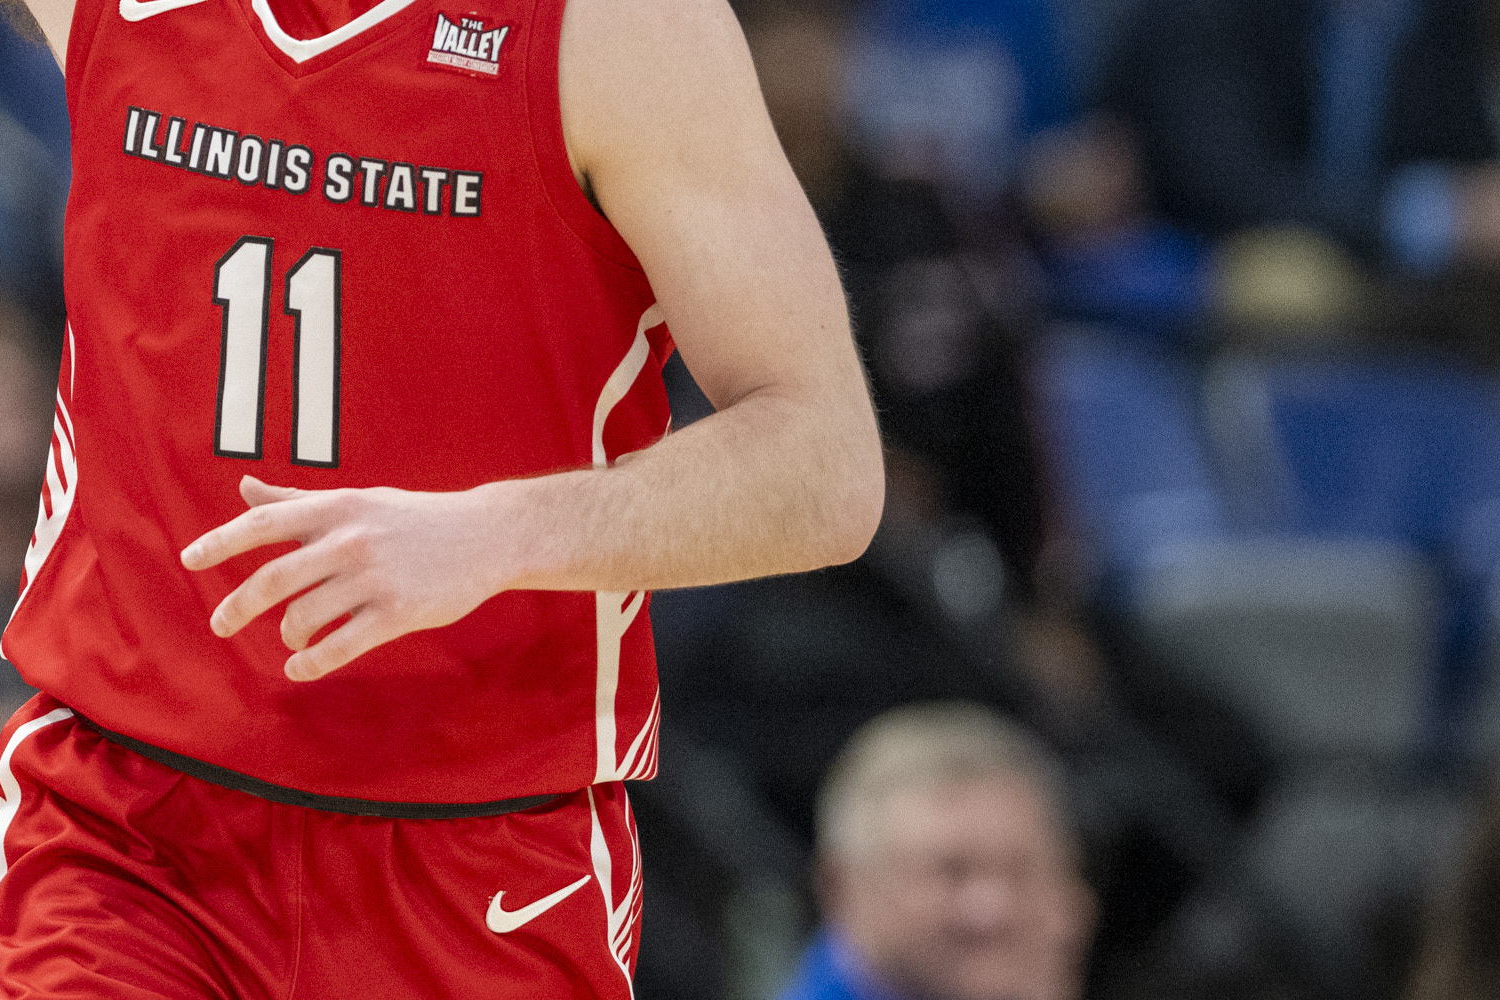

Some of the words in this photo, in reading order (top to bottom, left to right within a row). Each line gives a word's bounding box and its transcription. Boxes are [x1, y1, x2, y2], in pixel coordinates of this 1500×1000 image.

[432, 13, 509, 63] VALLEY
[461, 18, 483, 31] THE
[123, 106, 312, 194] ILLINOIS
[324, 153, 483, 217] STATE
[212, 235, 342, 469] 11
